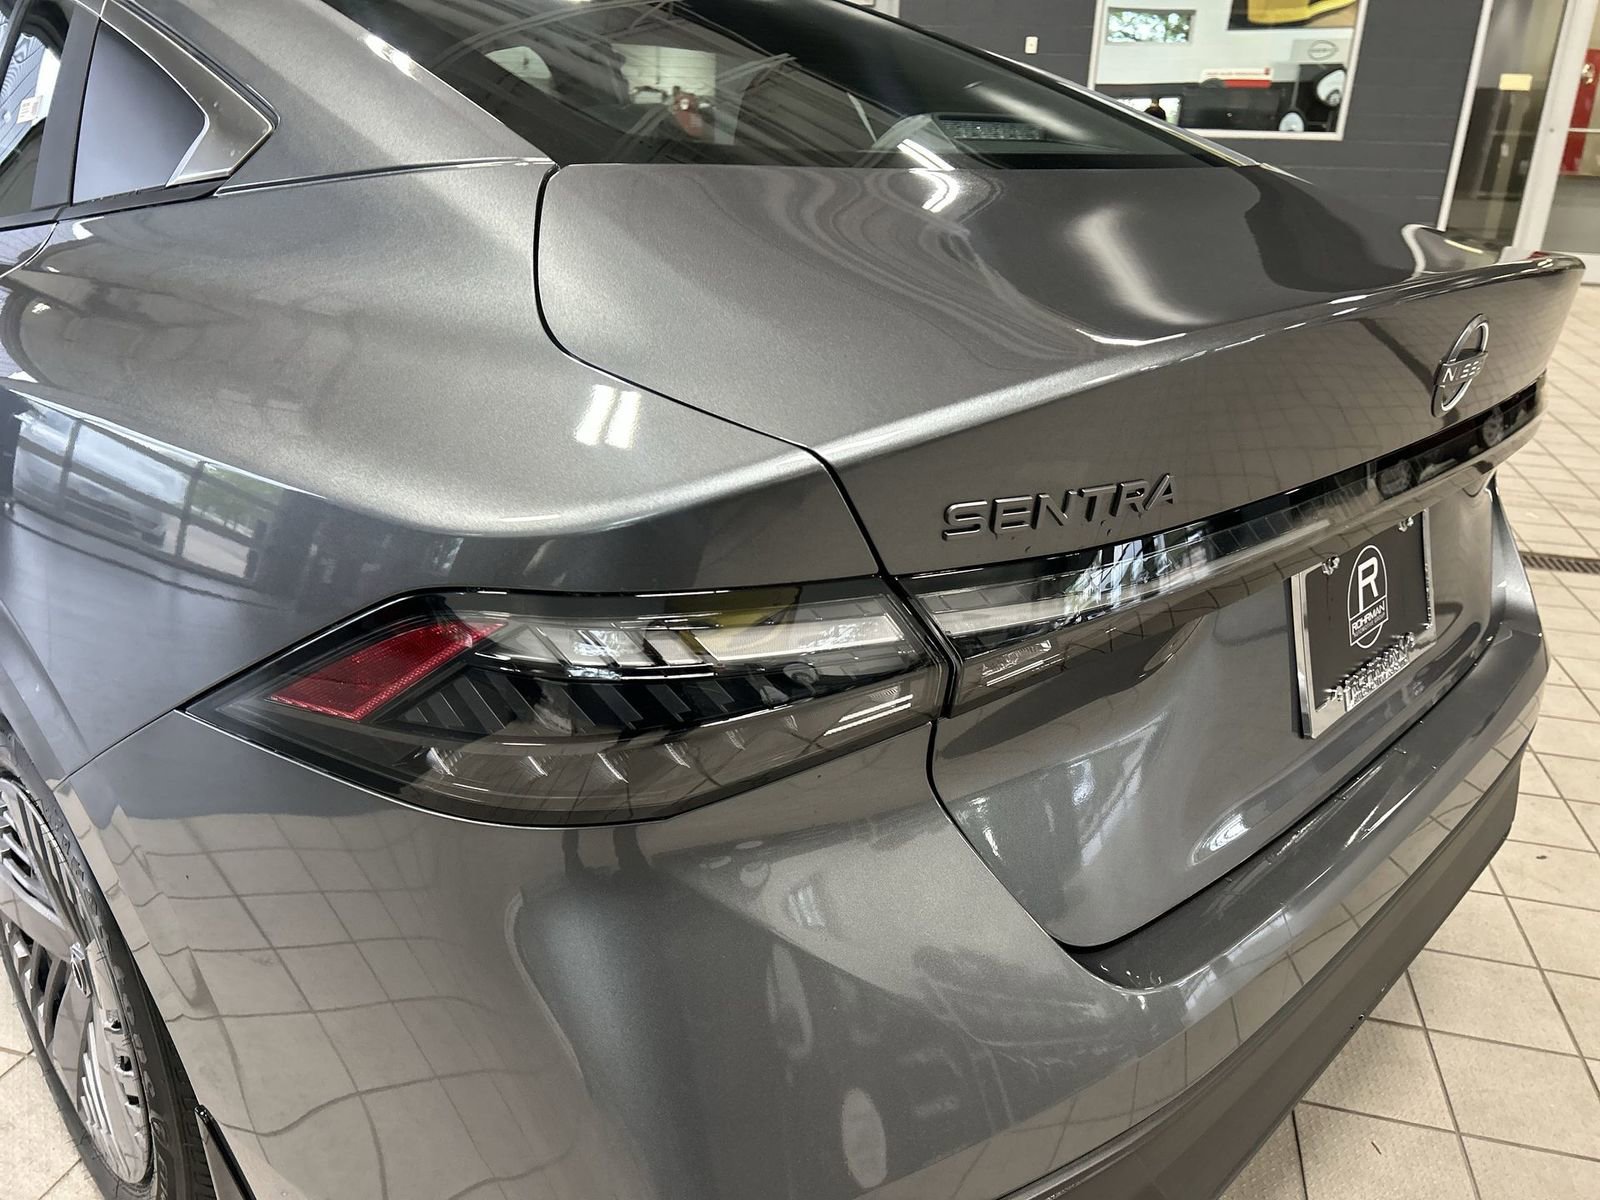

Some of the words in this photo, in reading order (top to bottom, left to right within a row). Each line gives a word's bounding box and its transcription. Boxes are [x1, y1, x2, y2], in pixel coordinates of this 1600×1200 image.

[942, 473, 1175, 541] SENTRA
[1357, 556, 1379, 613] R
[1352, 601, 1386, 635] ROHRMAN
